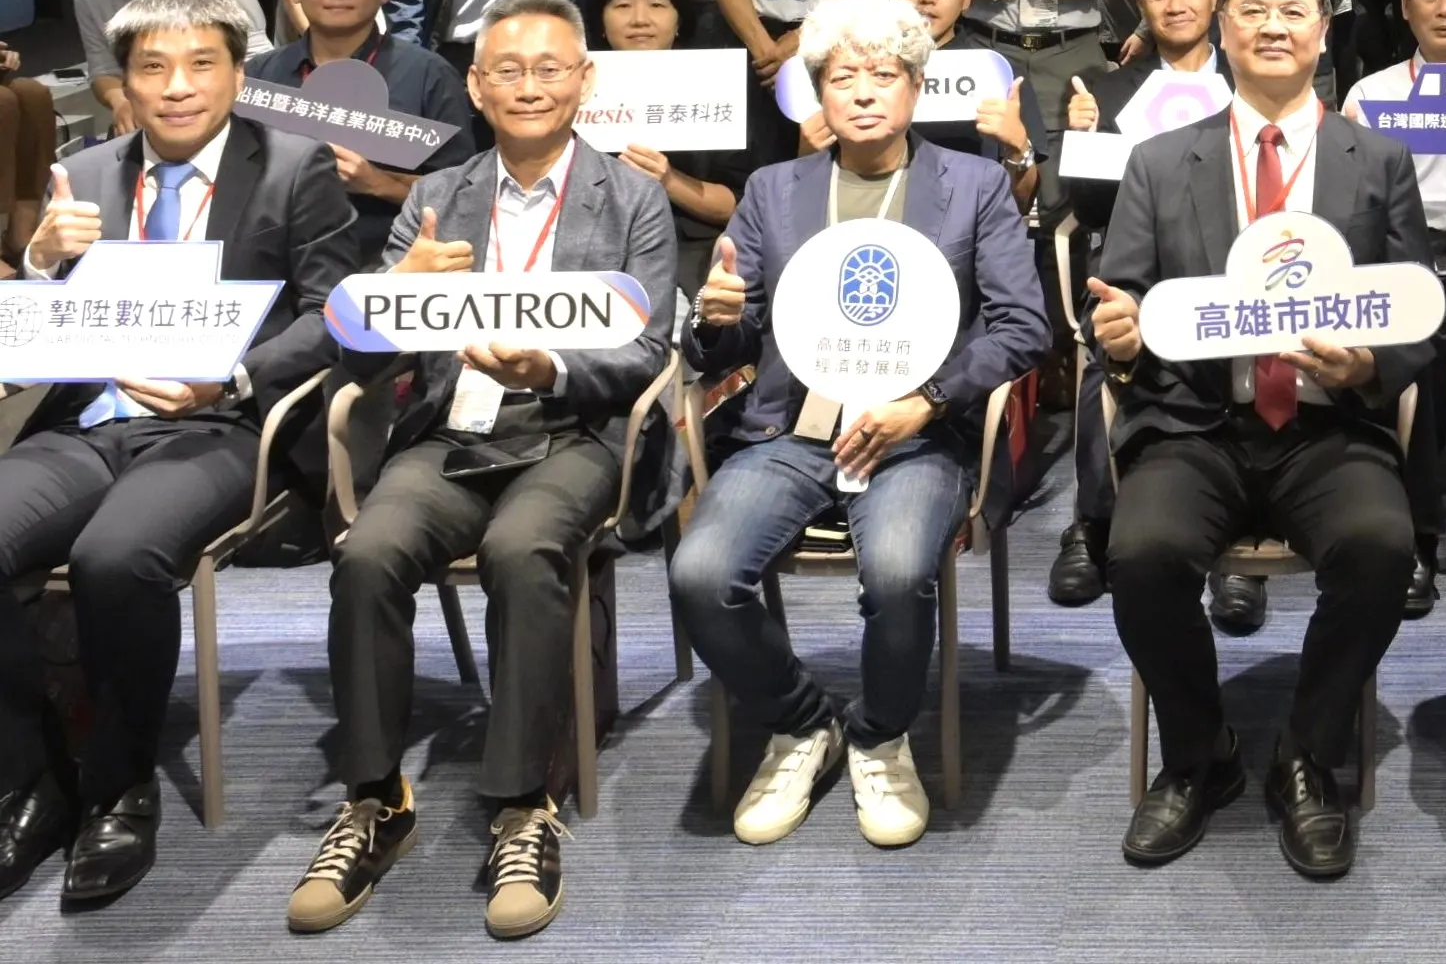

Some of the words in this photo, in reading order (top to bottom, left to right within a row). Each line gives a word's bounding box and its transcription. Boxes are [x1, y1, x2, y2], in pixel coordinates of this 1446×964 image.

[645, 102, 734, 125] 晉泰科技
[48, 299, 242, 328] 摯陞數位科技
[363, 292, 611, 331] PEGATRON
[1193, 290, 1392, 341] 高雄市政府
[817, 337, 912, 355] 高雄市政府
[814, 358, 911, 376] 經濟發展局
